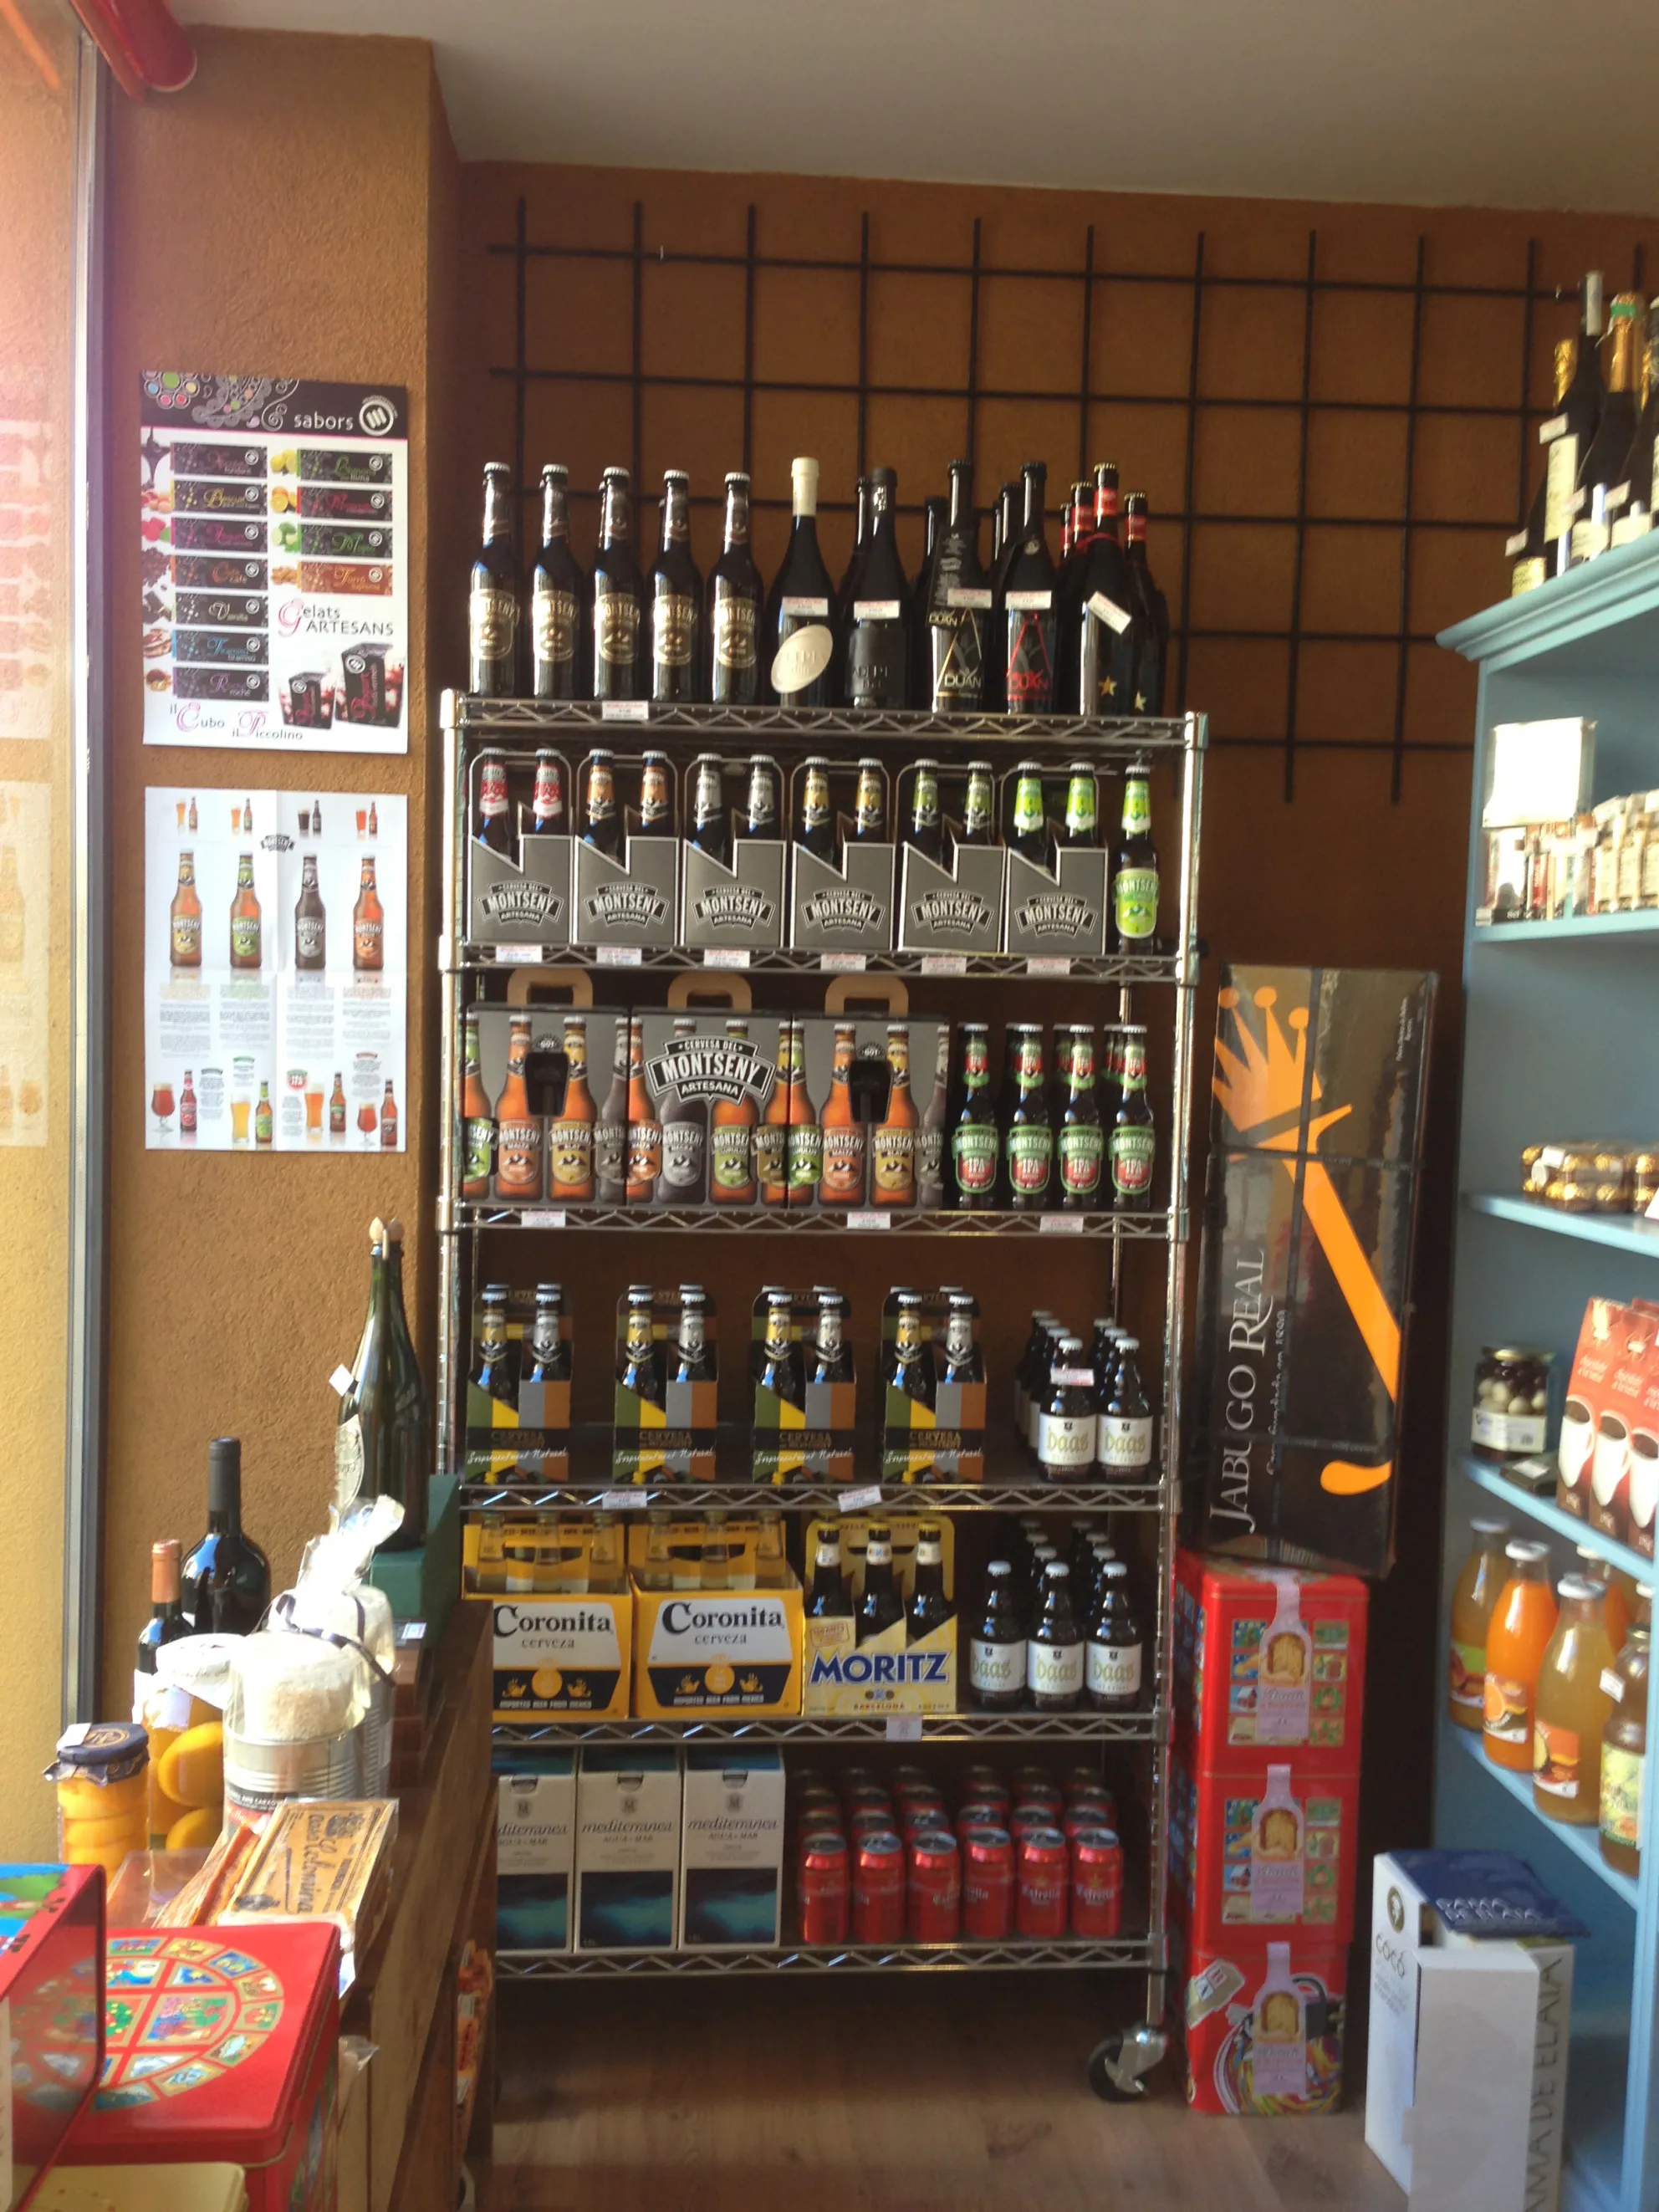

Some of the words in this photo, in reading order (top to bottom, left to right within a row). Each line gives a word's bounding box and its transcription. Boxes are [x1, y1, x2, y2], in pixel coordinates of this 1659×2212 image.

[294, 411, 353, 431] sabors
[278, 598, 340, 637] Gelats
[306, 620, 394, 636] ARTESANS
[176, 702, 225, 733] Cubo
[238, 709, 303, 741] Piccolino
[487, 891, 555, 914] MONTSENY
[594, 892, 661, 916] MONTSENY
[701, 895, 767, 917] MONTSENY
[811, 897, 876, 920] MONTSENY
[921, 899, 985, 922] MONTSENY
[1025, 903, 1089, 926] MONTSENY
[685, 1039, 720, 1051] CERVESA
[722, 1040, 738, 1051] DEL
[661, 1051, 760, 1084] MONTSENY
[681, 1080, 738, 1096] ARTESANA
[968, 1157, 985, 1174] IPA
[1023, 1157, 1039, 1174] IPA
[1073, 1157, 1090, 1174] IPA
[1126, 1157, 1142, 1174] IPA
[1228, 1249, 1274, 1356] REAL
[493, 1605, 610, 1638] Coronita
[662, 1602, 782, 1634] Coronita
[521, 1637, 575, 1650] cerveza
[694, 1632, 747, 1646] cerveza
[808, 1651, 949, 1685] MORITZ
